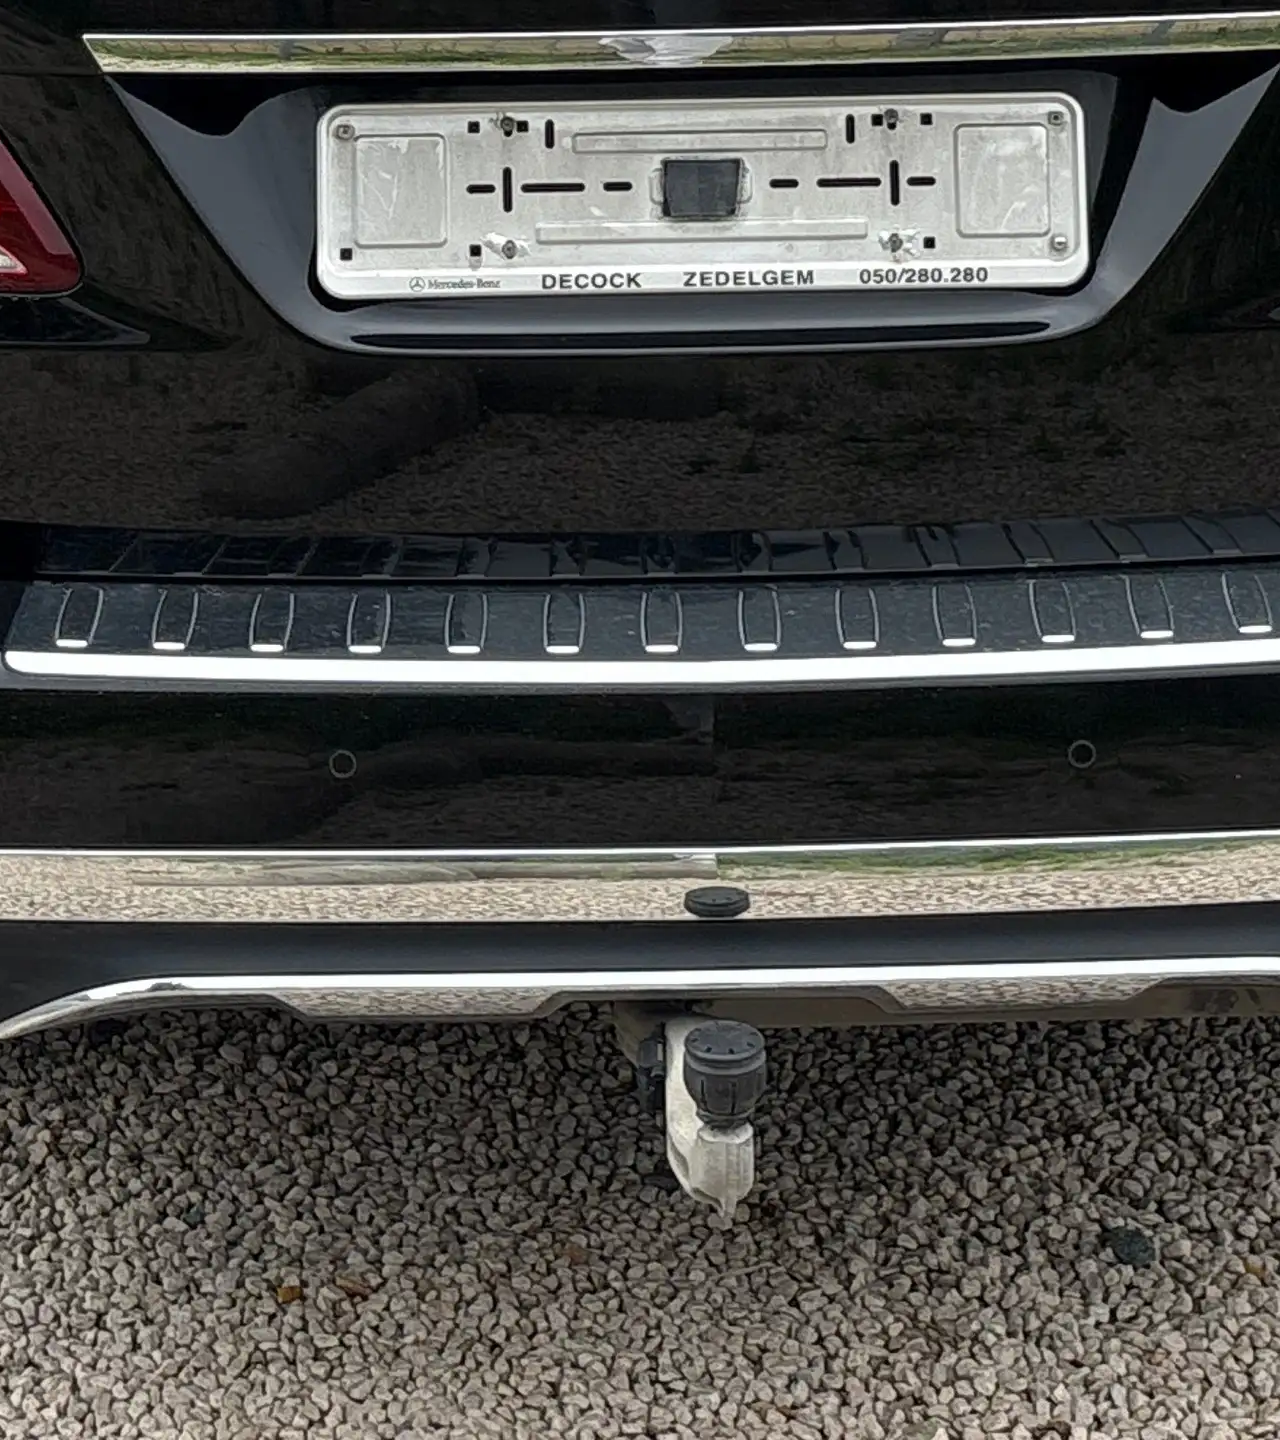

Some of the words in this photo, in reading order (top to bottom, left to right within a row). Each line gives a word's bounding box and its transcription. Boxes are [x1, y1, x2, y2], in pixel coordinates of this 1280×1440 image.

[427, 278, 501, 290] Mercedes-Benz
[541, 273, 642, 290] DECOCK
[683, 269, 815, 288] ZEDELGEM
[859, 267, 989, 285] 050/280.280
